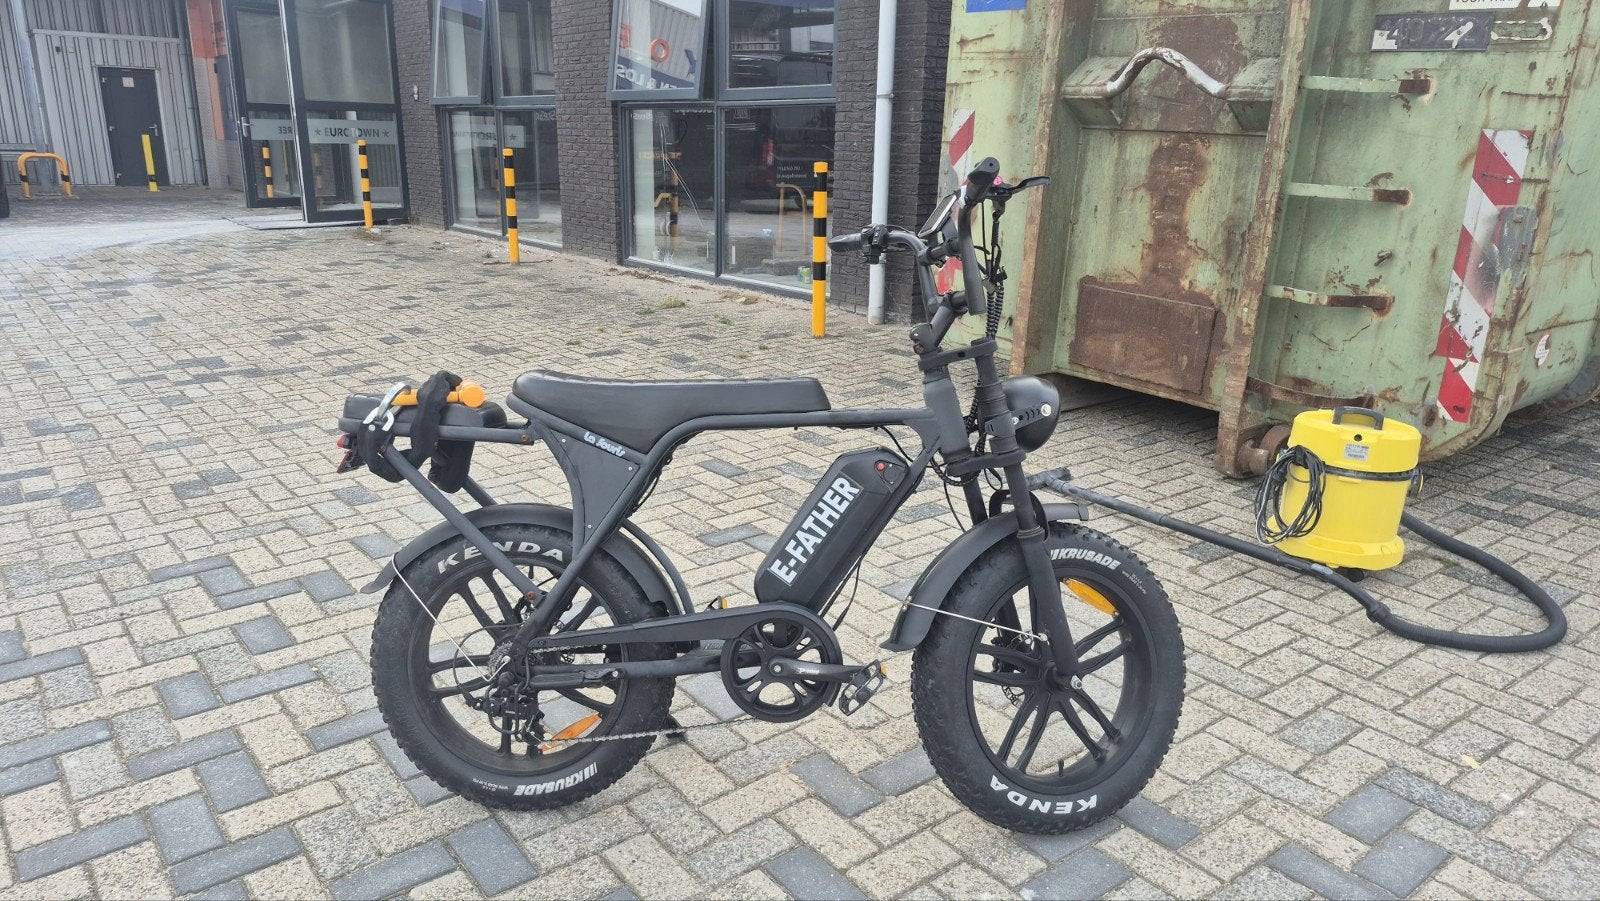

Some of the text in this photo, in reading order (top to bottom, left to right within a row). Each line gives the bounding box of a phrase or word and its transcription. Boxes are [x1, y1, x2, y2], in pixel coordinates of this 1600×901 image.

[770, 476, 860, 585] E-FATHER
[437, 540, 564, 575] KENDA
[989, 774, 1099, 815] KENDA
